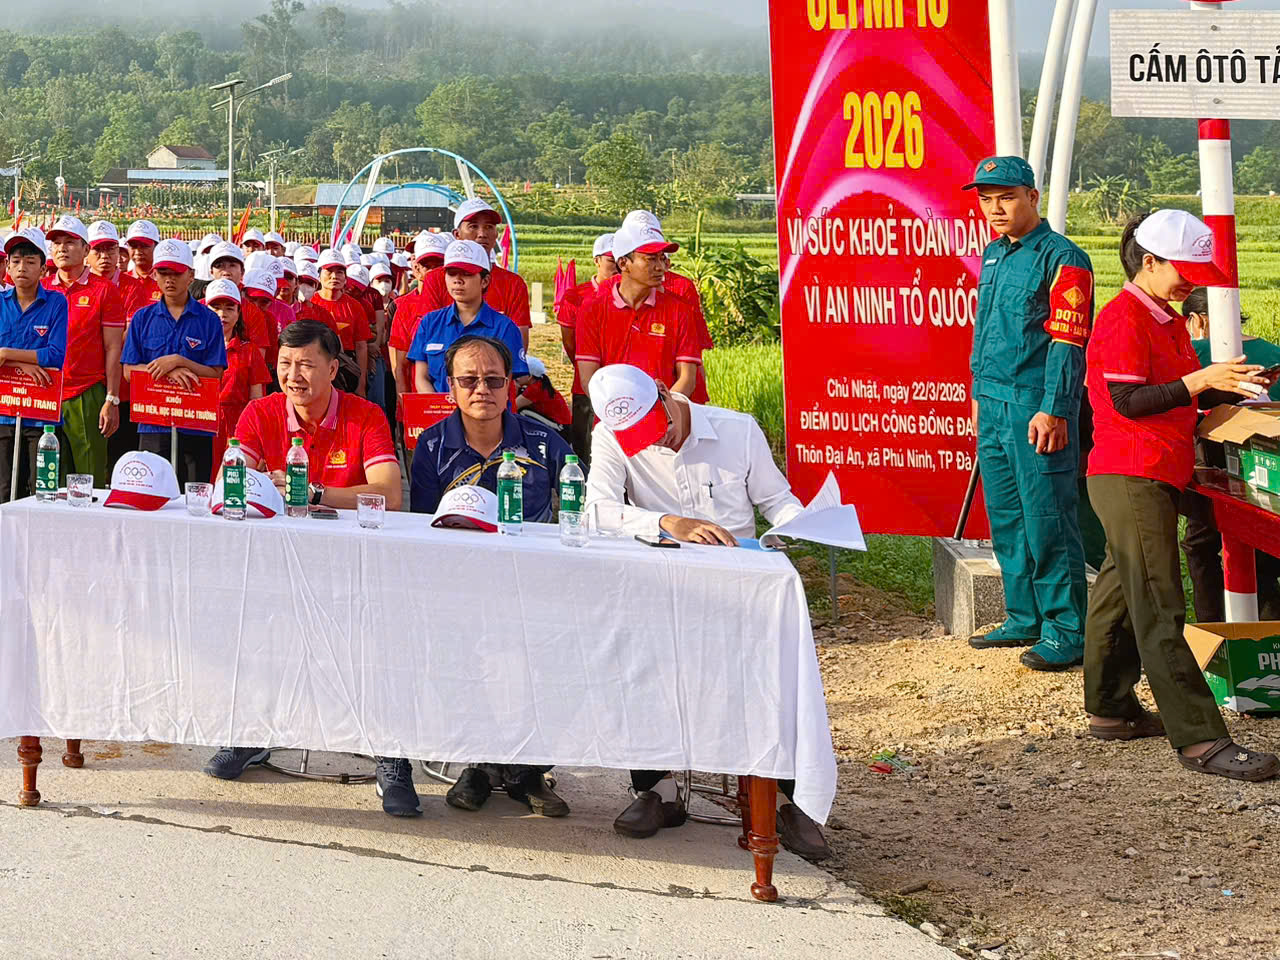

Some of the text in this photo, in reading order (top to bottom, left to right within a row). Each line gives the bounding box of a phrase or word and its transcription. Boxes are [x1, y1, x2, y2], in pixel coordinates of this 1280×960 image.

[1128, 42, 1187, 83] CẤM
[1195, 48, 1247, 84] ÔTÔ
[843, 91, 924, 169] 2026
[787, 204, 991, 257] VÌ SỨC KHOẺ TOÀN DÂN
[804, 267, 978, 328] VÌ AN NINH TỔ QUỐC
[34, 399, 57, 411] TRANG
[827, 377, 966, 404] Chủ Nhật, ngày 22/3/2026
[800, 402, 977, 441] ĐIỂM DU LỊCH CỘNG ĐỒNG ĐẠ
[796, 444, 972, 472] Thôn Đại An, xã Phú Ninh, TP Đà
[1257, 652, 1280, 670] PH
